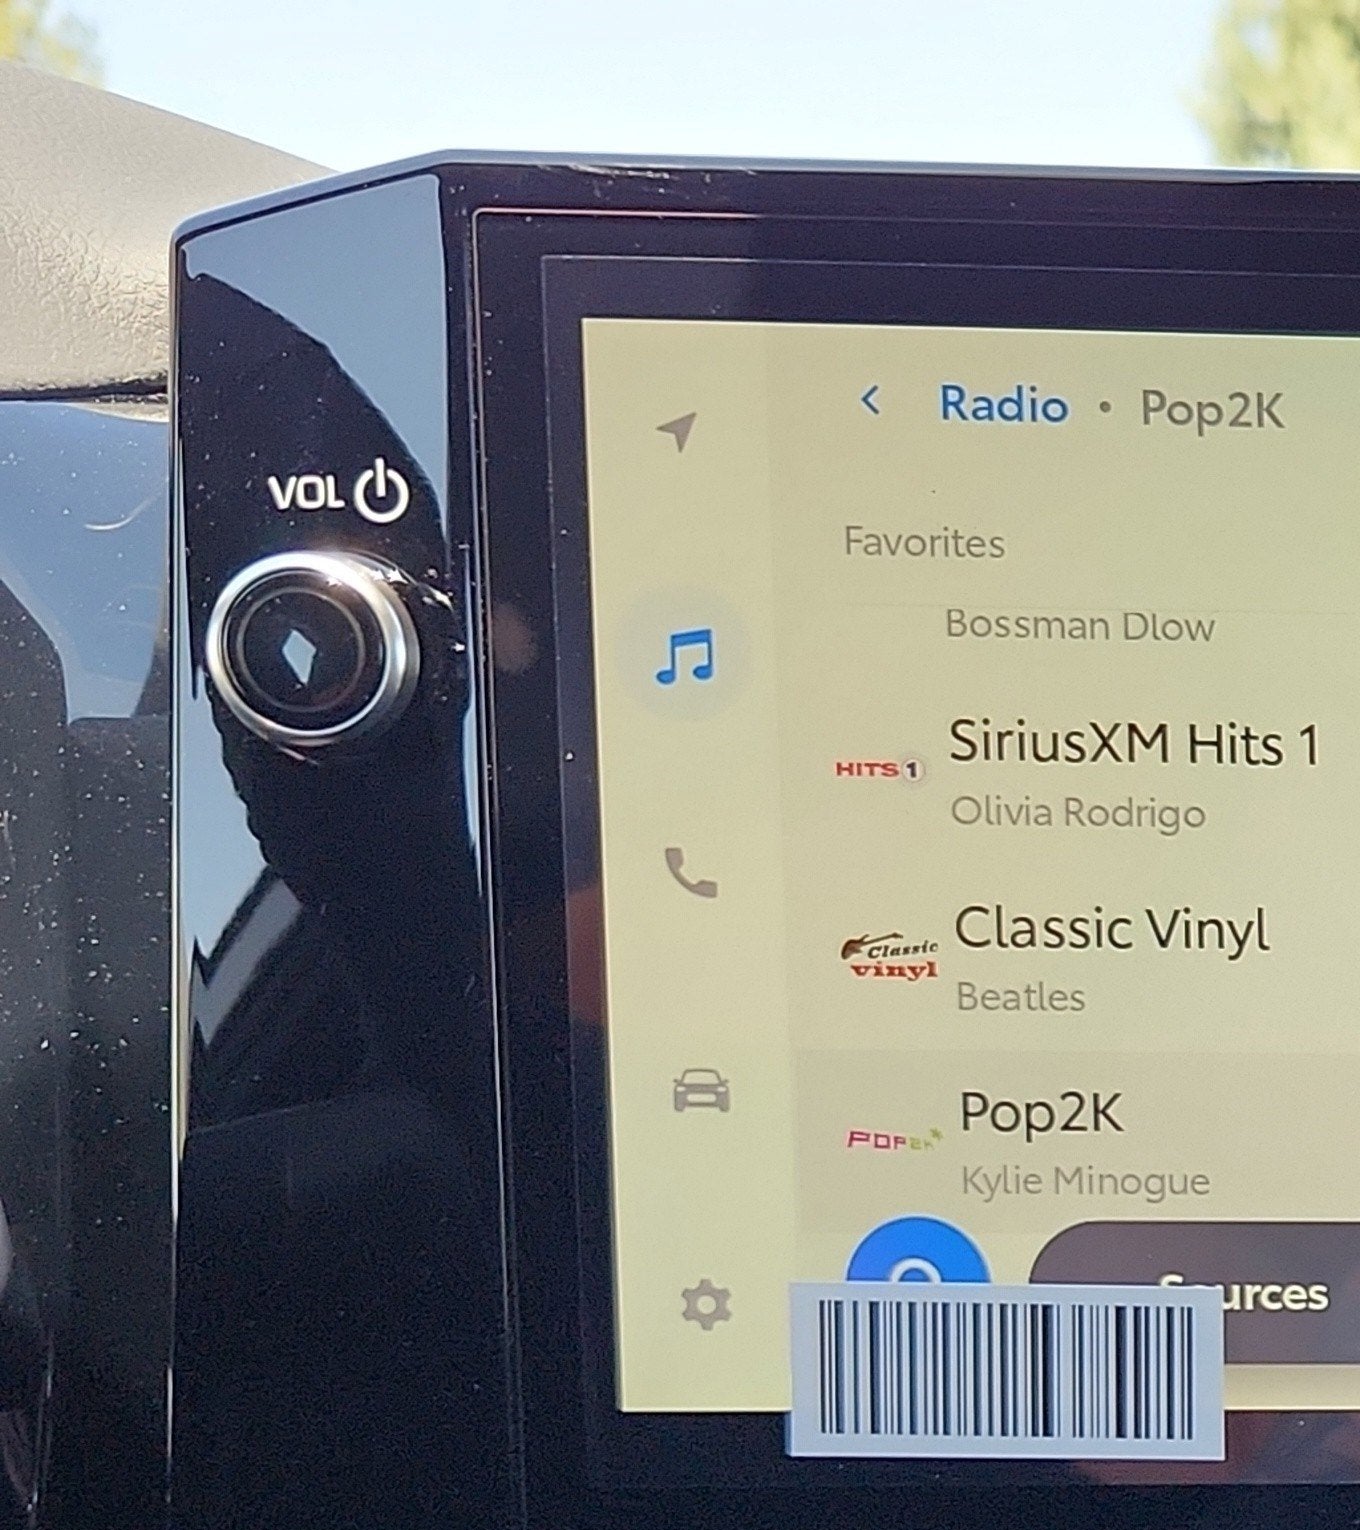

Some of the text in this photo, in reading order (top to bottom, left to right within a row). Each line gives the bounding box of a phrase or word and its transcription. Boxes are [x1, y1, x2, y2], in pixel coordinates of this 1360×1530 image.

[941, 384, 1286, 437] Radio Pop2K
[267, 474, 346, 511] VOL
[844, 525, 1006, 560] Favorites
[945, 608, 1217, 643] Bossman Dlow
[950, 717, 1317, 766] SiriusXM Hits 1
[835, 760, 900, 779] HITS
[950, 794, 1207, 837] Olivia Rodrigo
[866, 938, 939, 960] Classic
[955, 903, 1271, 962] Classic Vinyl
[850, 960, 939, 982] vinyl
[957, 980, 1087, 1013] Beatles
[960, 1091, 1125, 1143] Pop2K
[961, 1164, 1212, 1205] Kylie Minogue
[1159, 1273, 1330, 1311] urces
